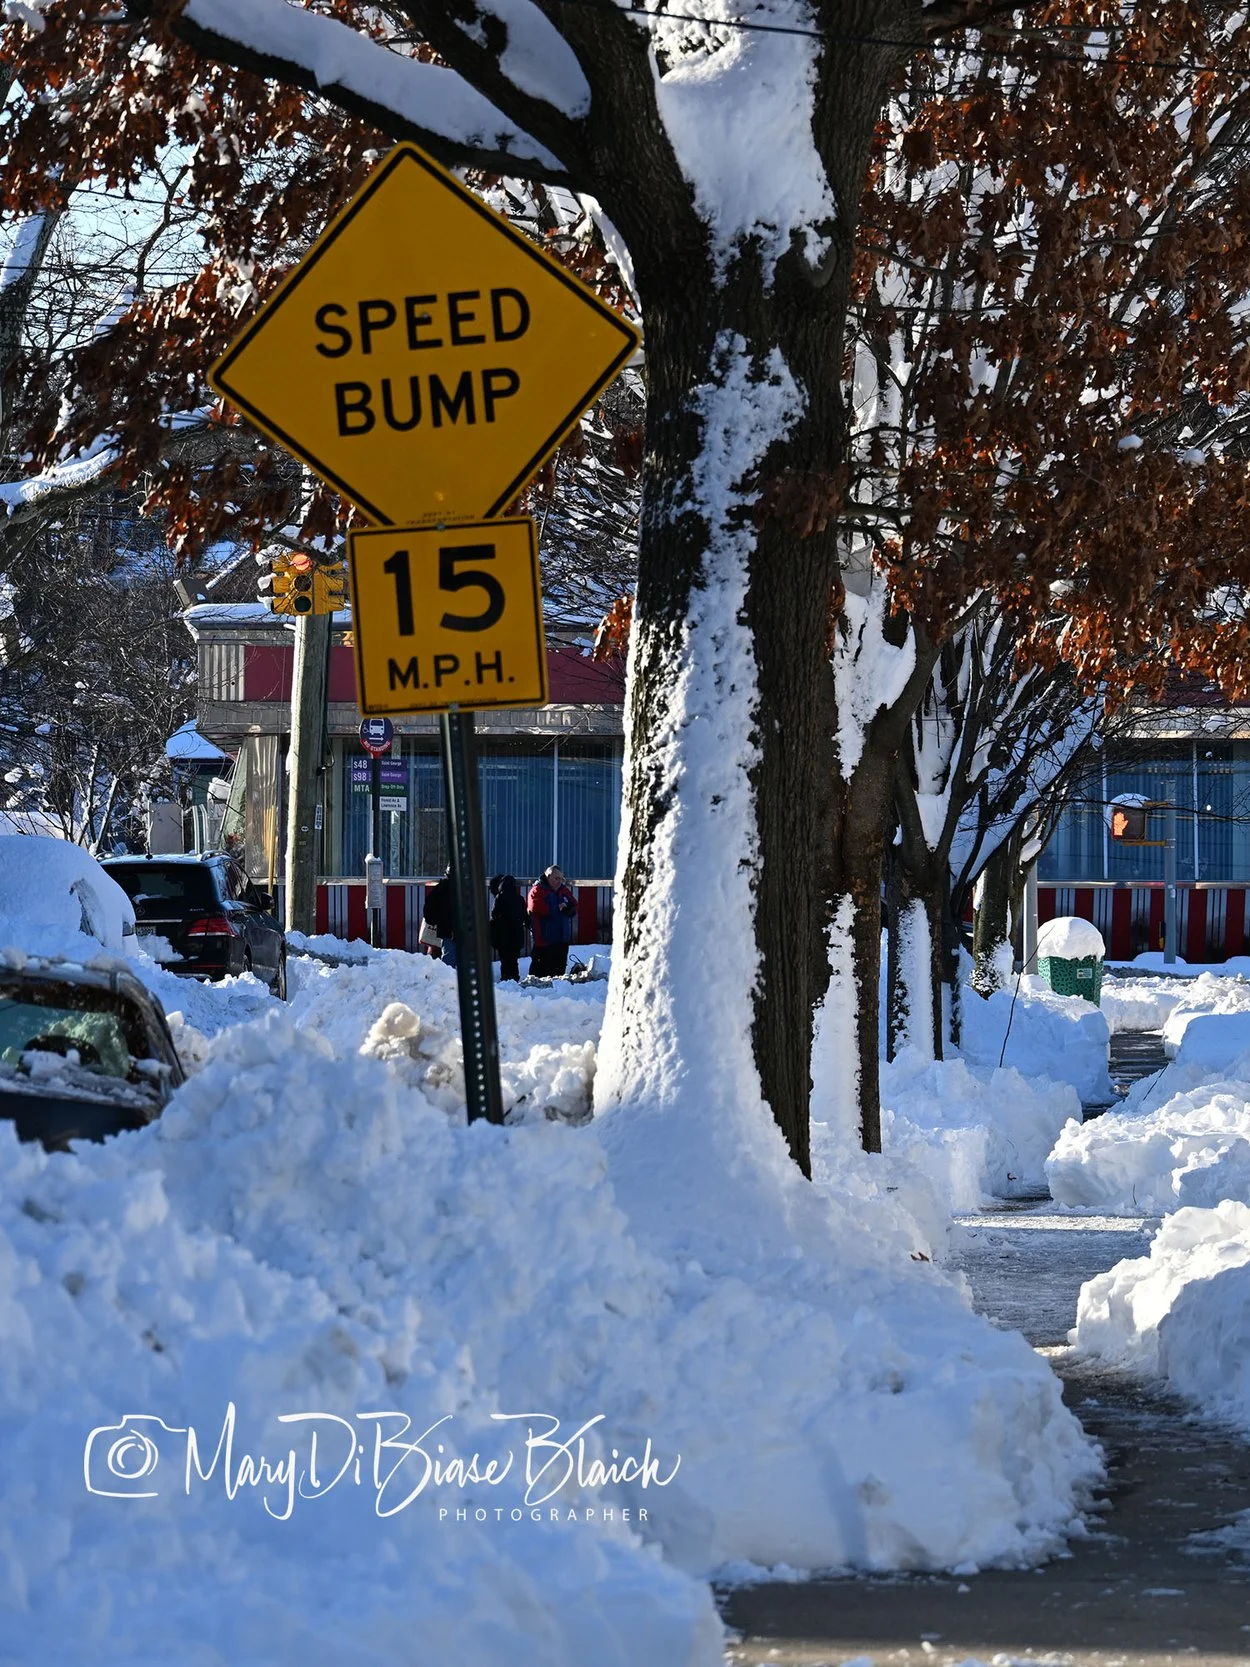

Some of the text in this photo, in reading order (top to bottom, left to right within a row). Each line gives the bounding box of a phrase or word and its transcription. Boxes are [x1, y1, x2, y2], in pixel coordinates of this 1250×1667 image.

[315, 287, 531, 358] SPEED
[335, 367, 520, 436] BUMP
[383, 543, 506, 636] 15
[387, 650, 515, 691] M.P.H.
[354, 784, 370, 792] MTA
